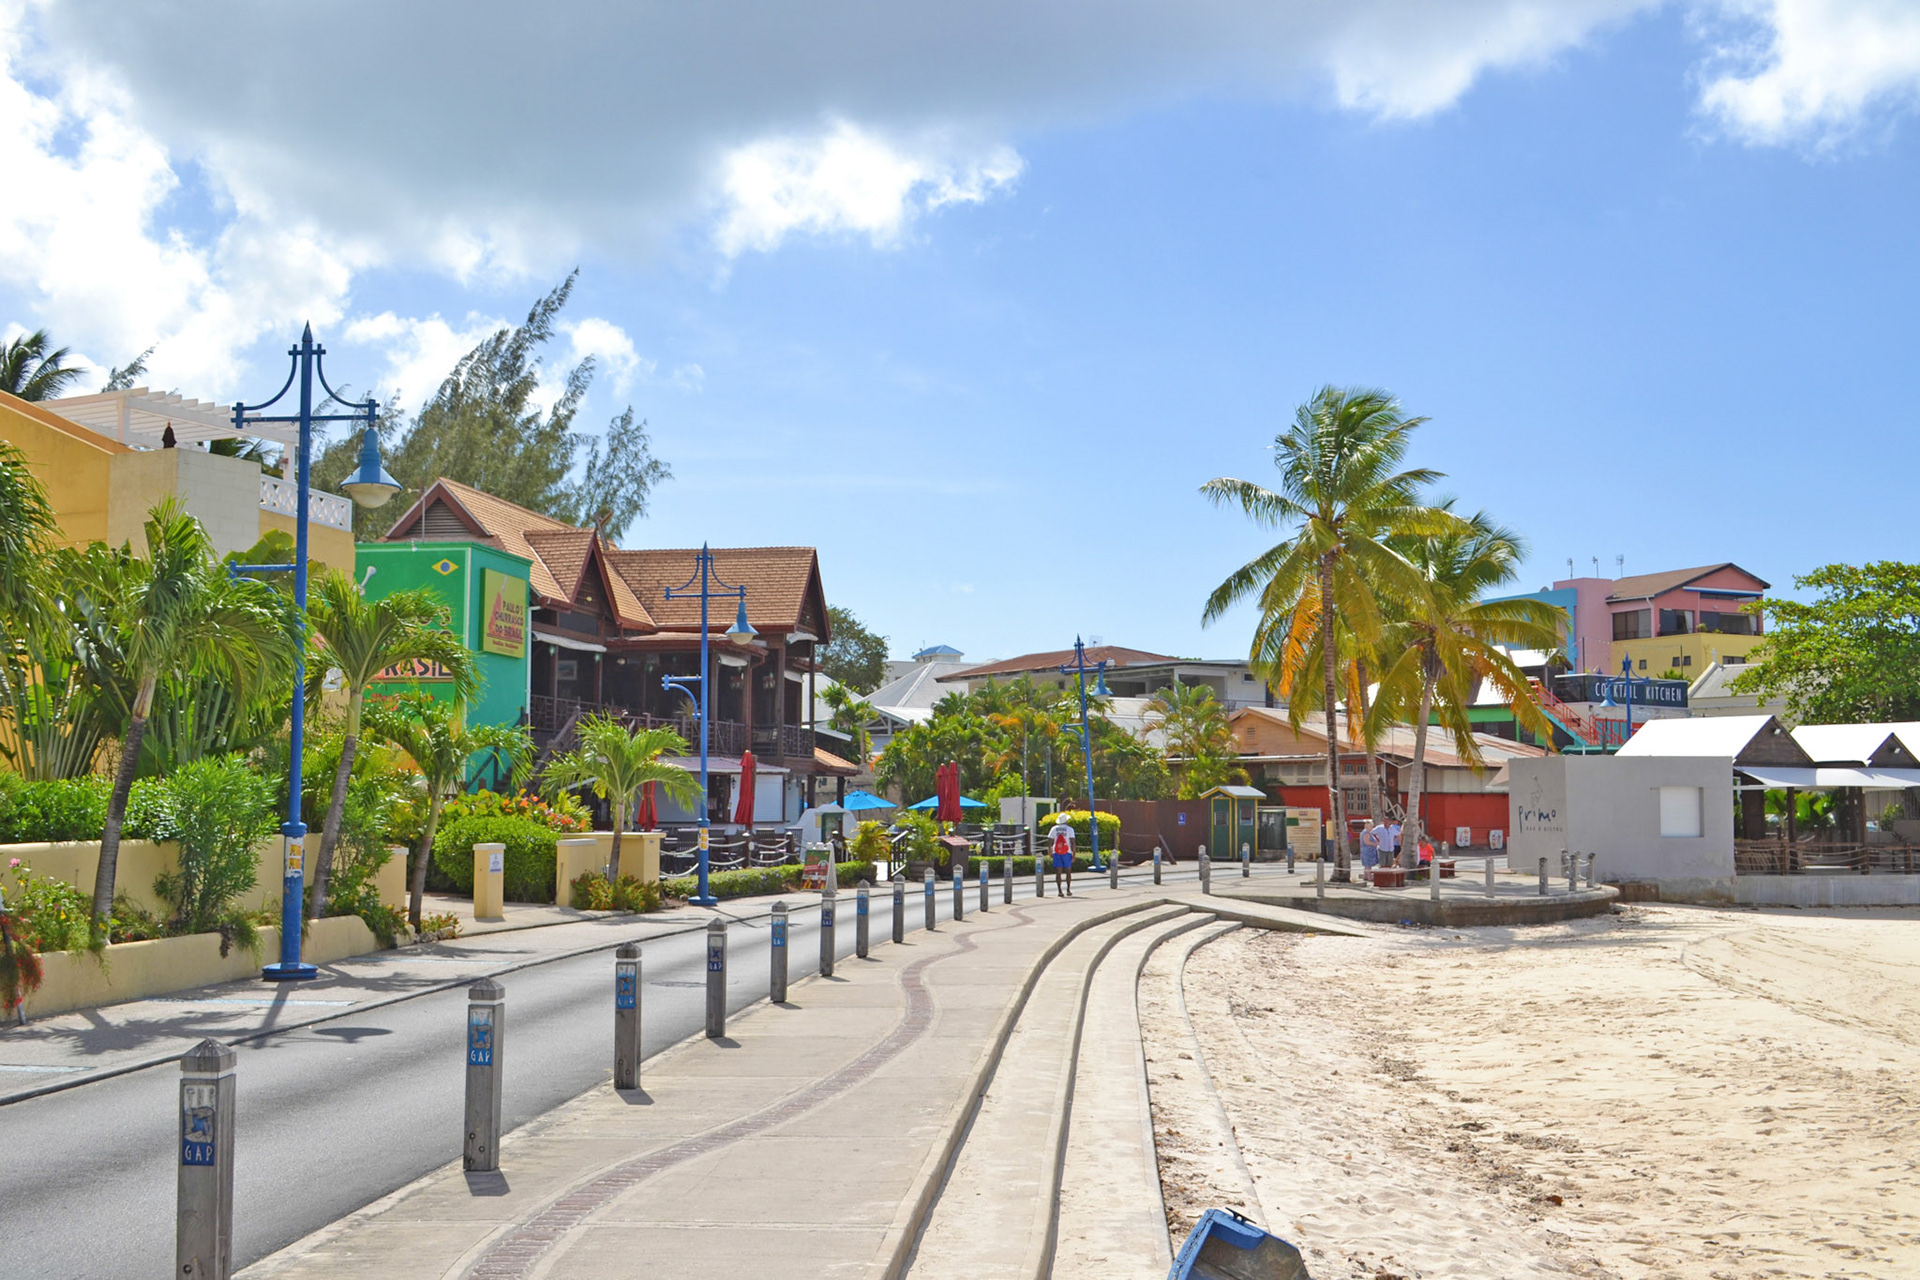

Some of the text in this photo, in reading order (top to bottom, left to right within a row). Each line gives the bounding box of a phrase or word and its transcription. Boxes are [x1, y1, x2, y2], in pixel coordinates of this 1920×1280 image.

[1645, 686, 1682, 702] KITCHEN
[470, 1049, 491, 1063] GAP
[184, 1144, 213, 1162] GAP
